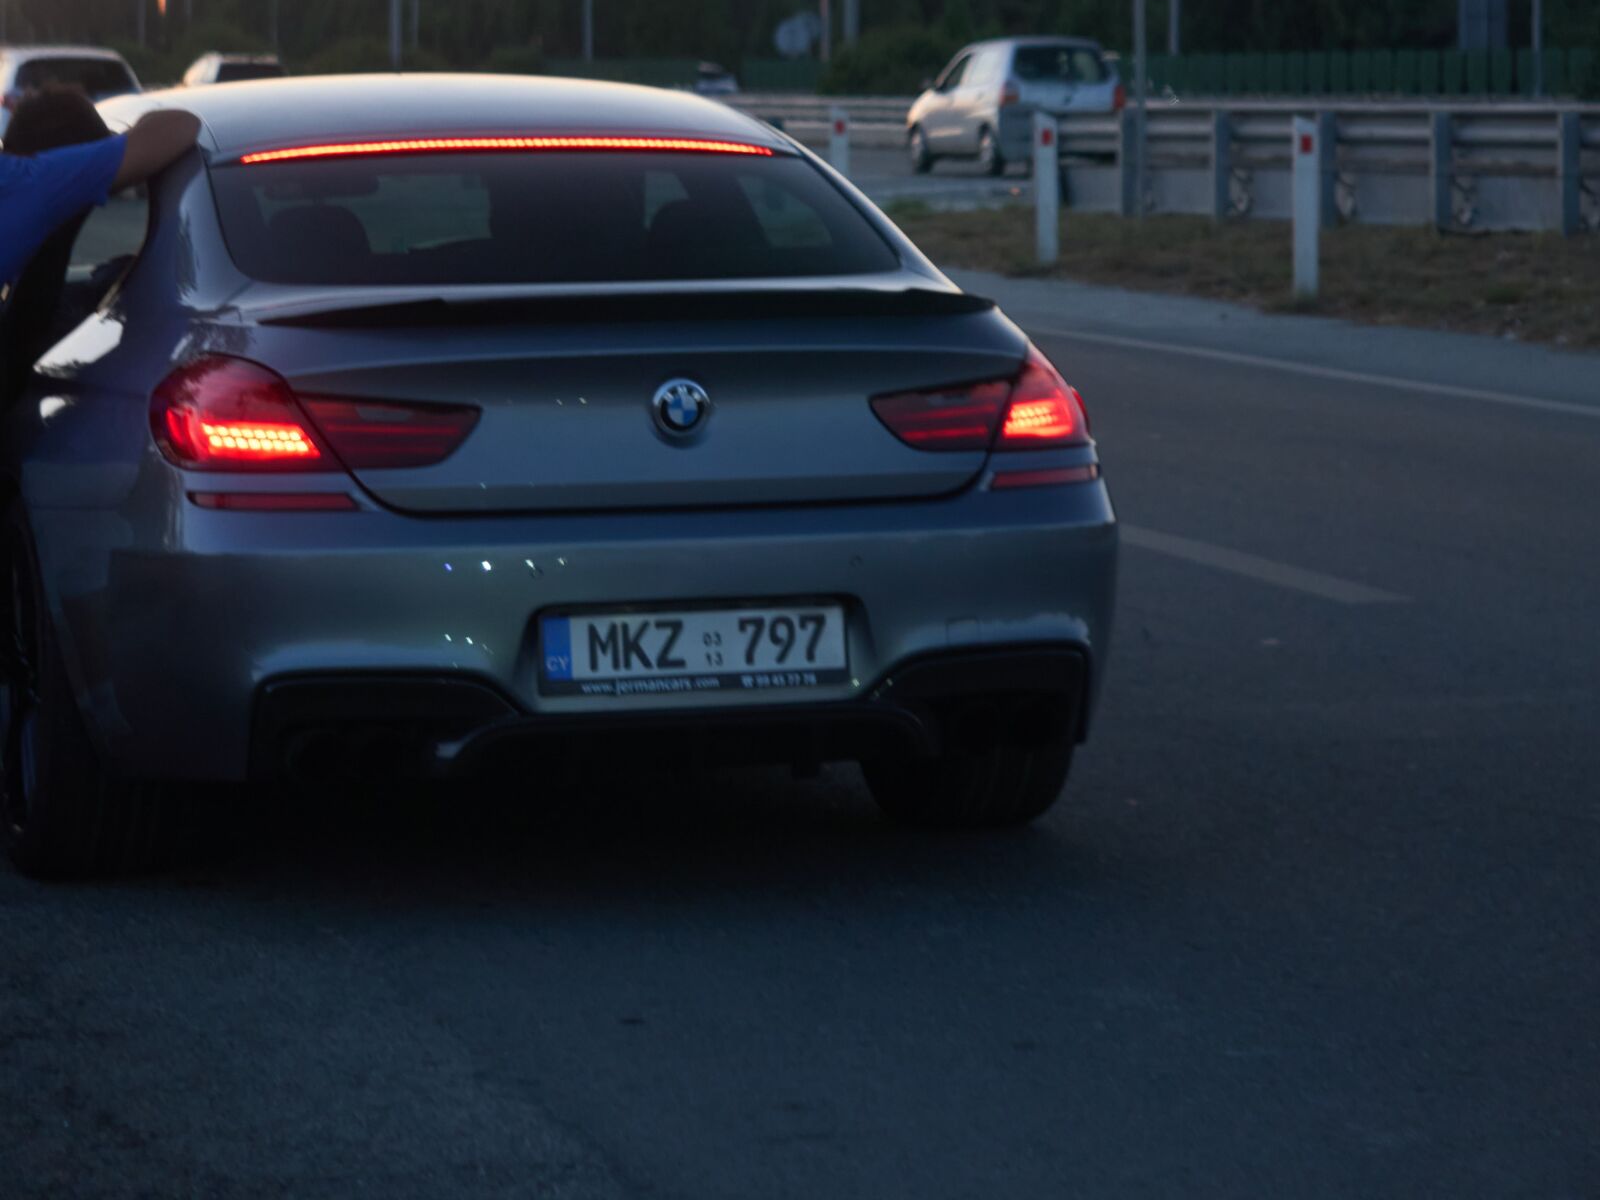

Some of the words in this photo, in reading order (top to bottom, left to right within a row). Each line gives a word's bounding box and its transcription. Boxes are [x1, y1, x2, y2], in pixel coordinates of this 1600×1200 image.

[588, 619, 686, 672] MKZ
[738, 614, 826, 665] 797
[546, 655, 569, 672] CY
